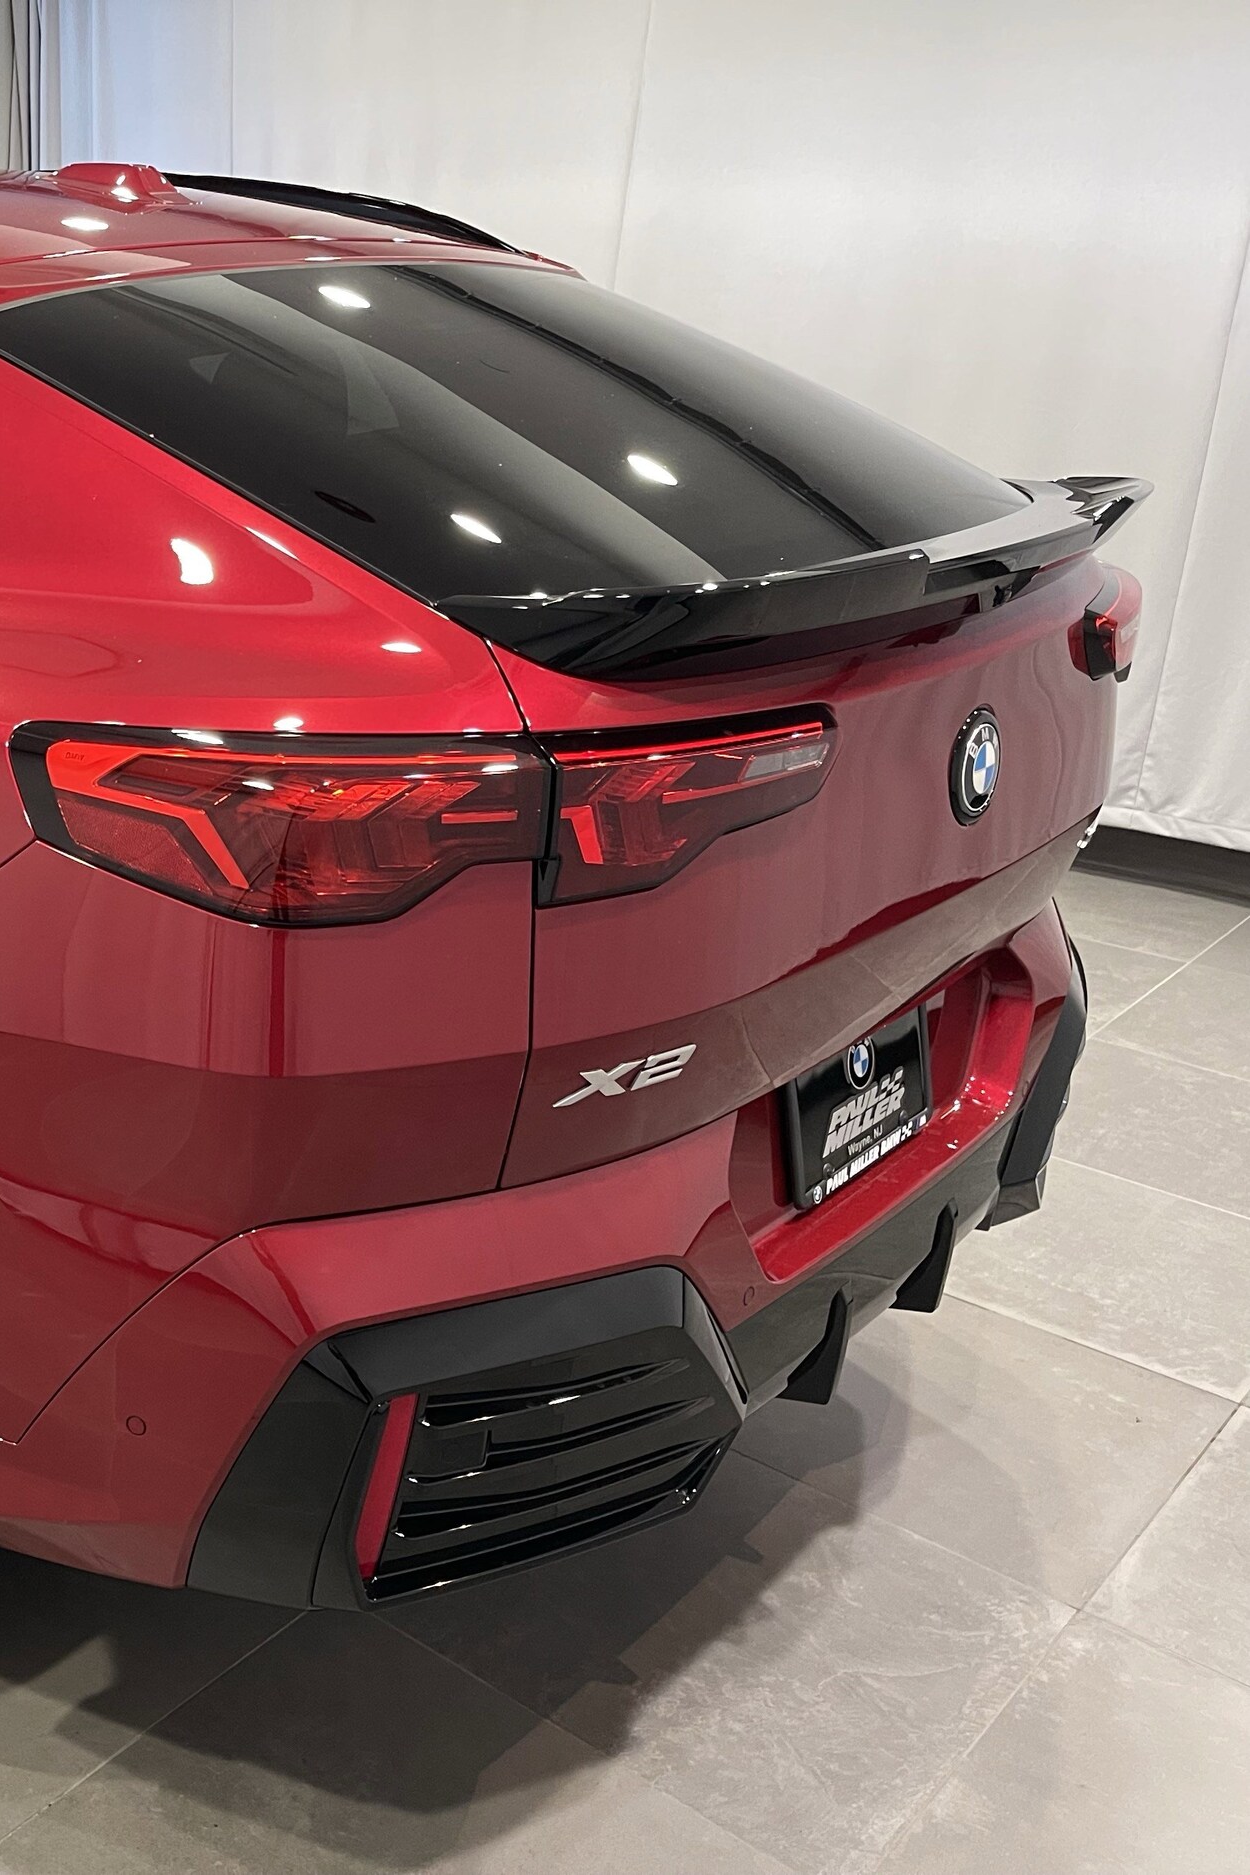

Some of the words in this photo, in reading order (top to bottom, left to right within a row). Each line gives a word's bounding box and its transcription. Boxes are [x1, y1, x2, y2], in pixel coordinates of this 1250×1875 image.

[969, 727, 999, 760] BMW
[552, 1043, 697, 1108] X2
[822, 1086, 906, 1159] MILLER
[828, 1085, 880, 1134] PAUL
[873, 1124, 883, 1139] NJ
[826, 1167, 849, 1195] PAUL
[849, 1145, 880, 1178] MILLER
